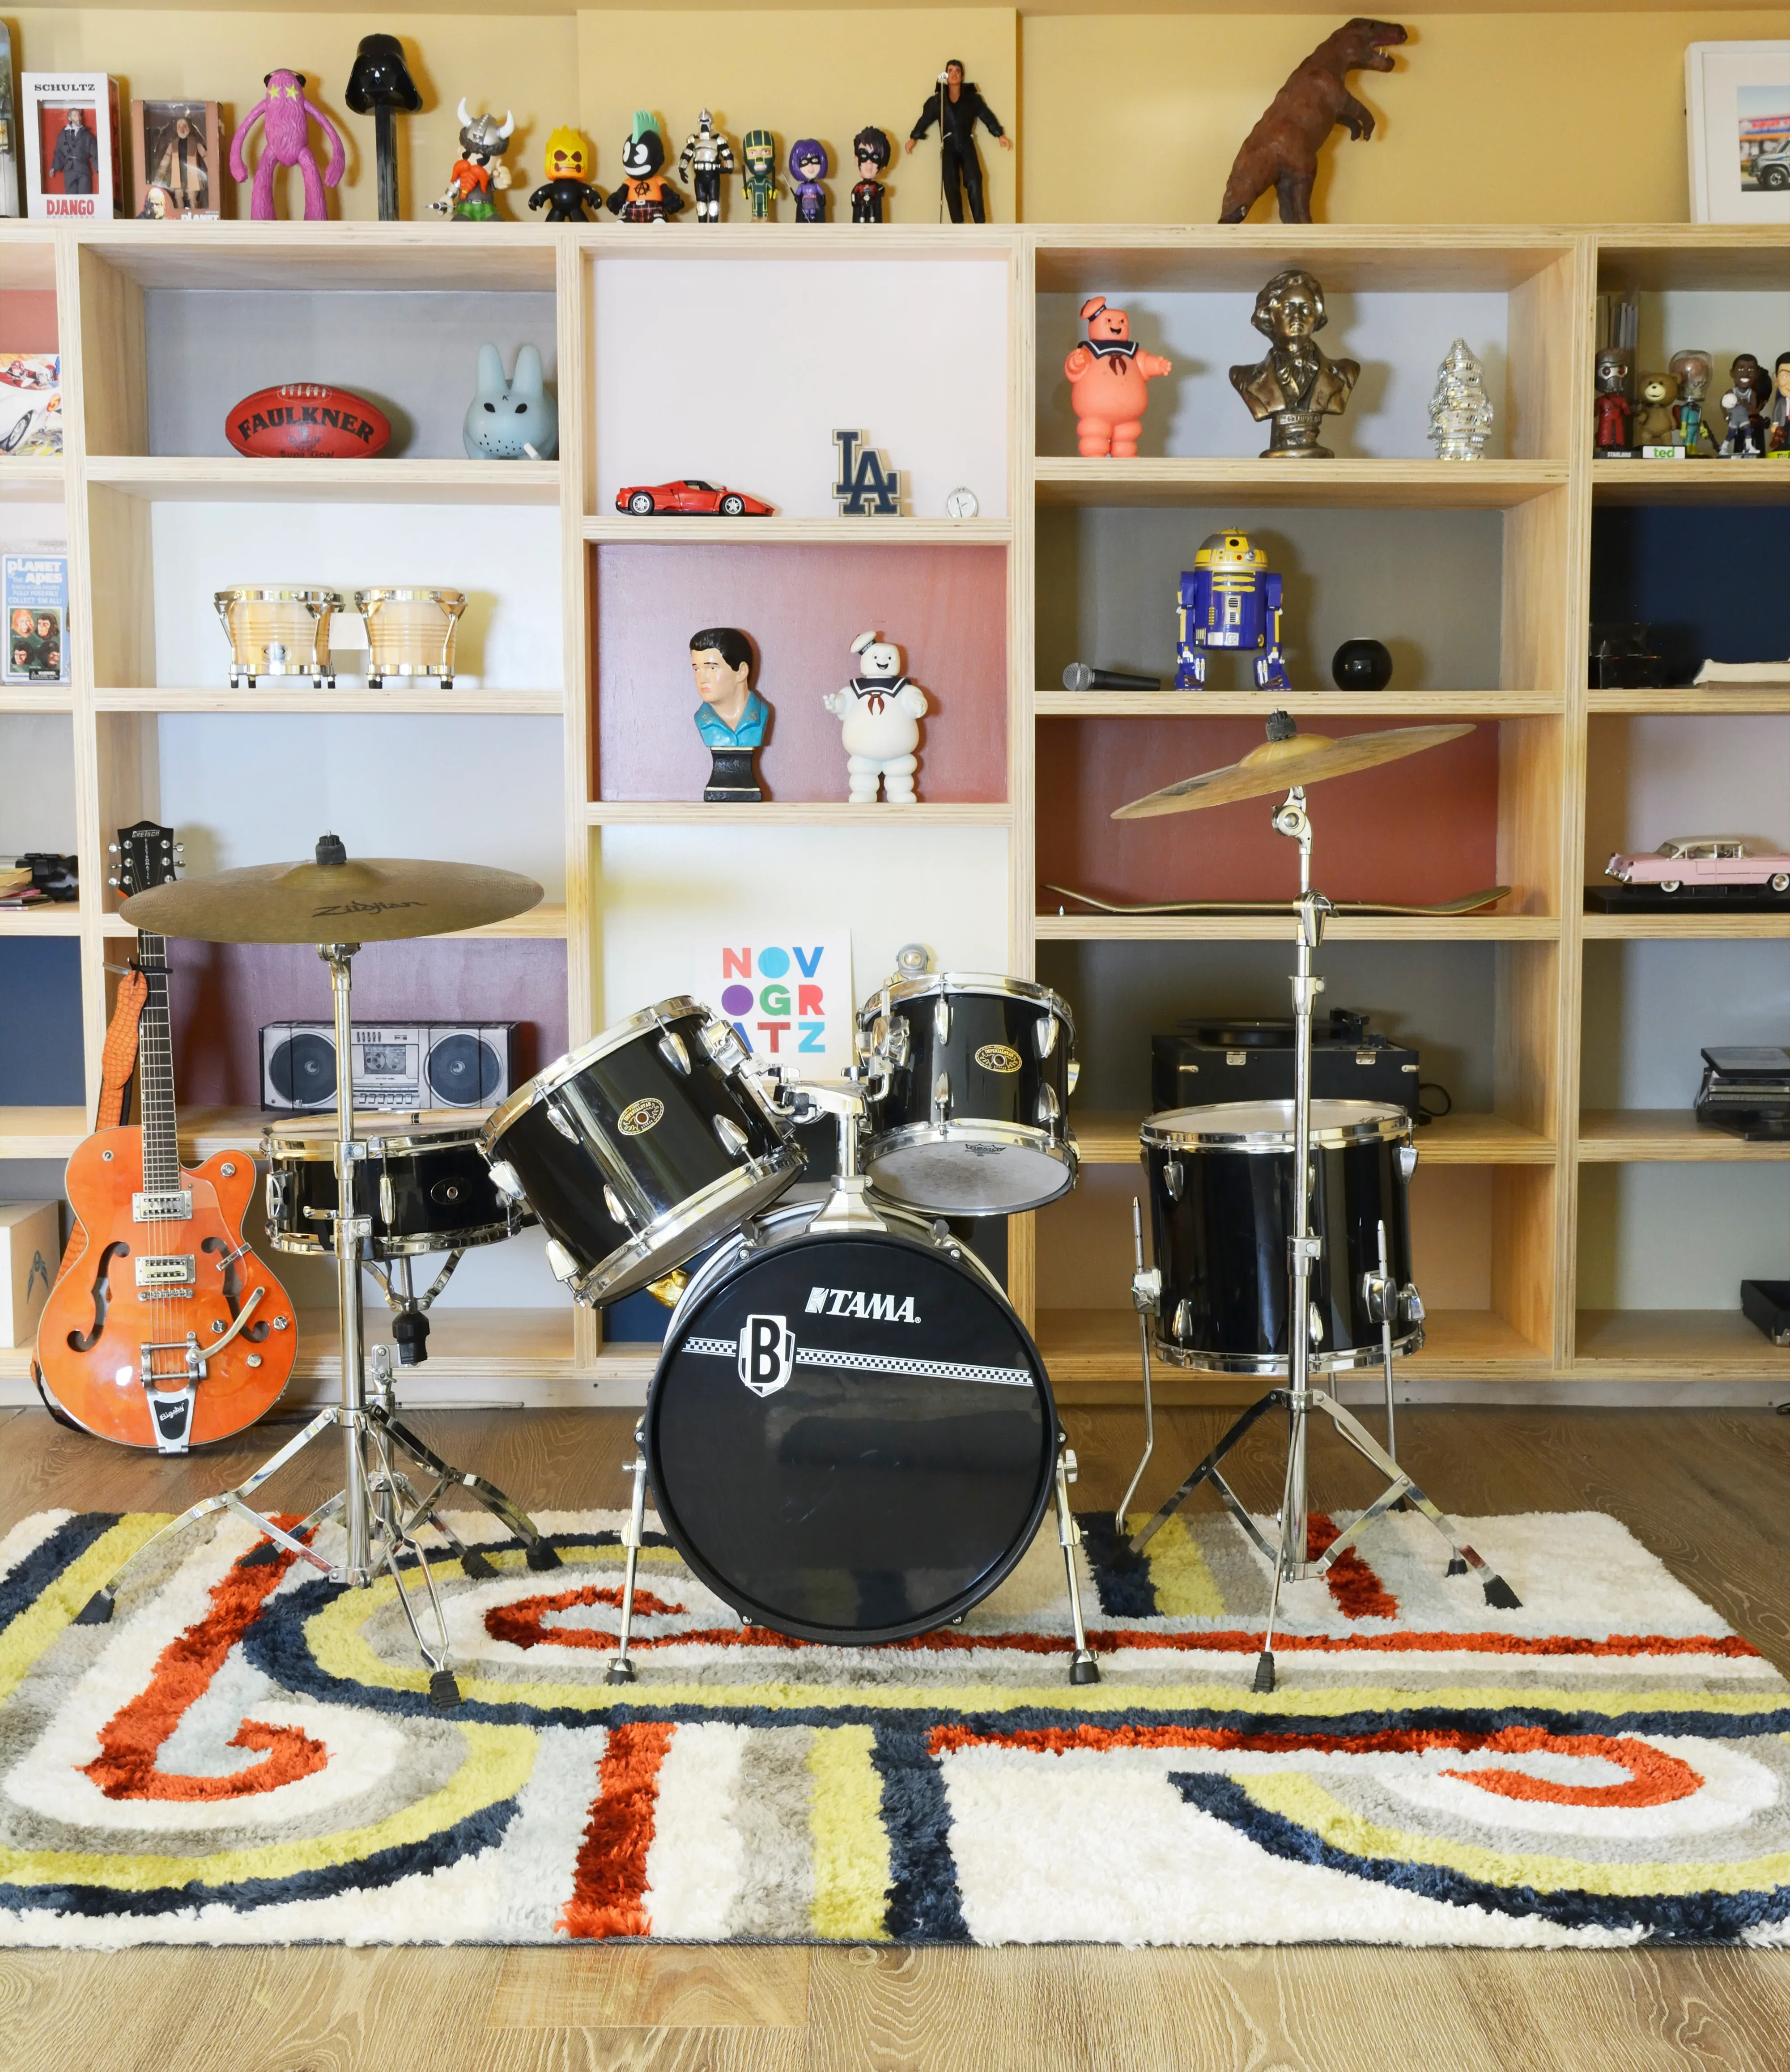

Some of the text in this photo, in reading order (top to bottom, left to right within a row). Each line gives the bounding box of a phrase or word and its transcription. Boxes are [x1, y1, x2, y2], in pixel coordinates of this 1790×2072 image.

[47, 199, 94, 215] DJANGO
[237, 407, 374, 444] FAULKNER
[1654, 446, 1675, 458] ted
[832, 429, 901, 517] LA
[132, 829, 160, 838] GRETSCH
[311, 900, 428, 917] Zildjian
[723, 947, 825, 979] NOV
[721, 984, 825, 1016] OGR
[623, 1102, 651, 1121] IMPERIALSTAR
[826, 1289, 915, 1323] TAMA
[750, 1318, 780, 1384] B
[159, 1403, 184, 1421] Bigsby
